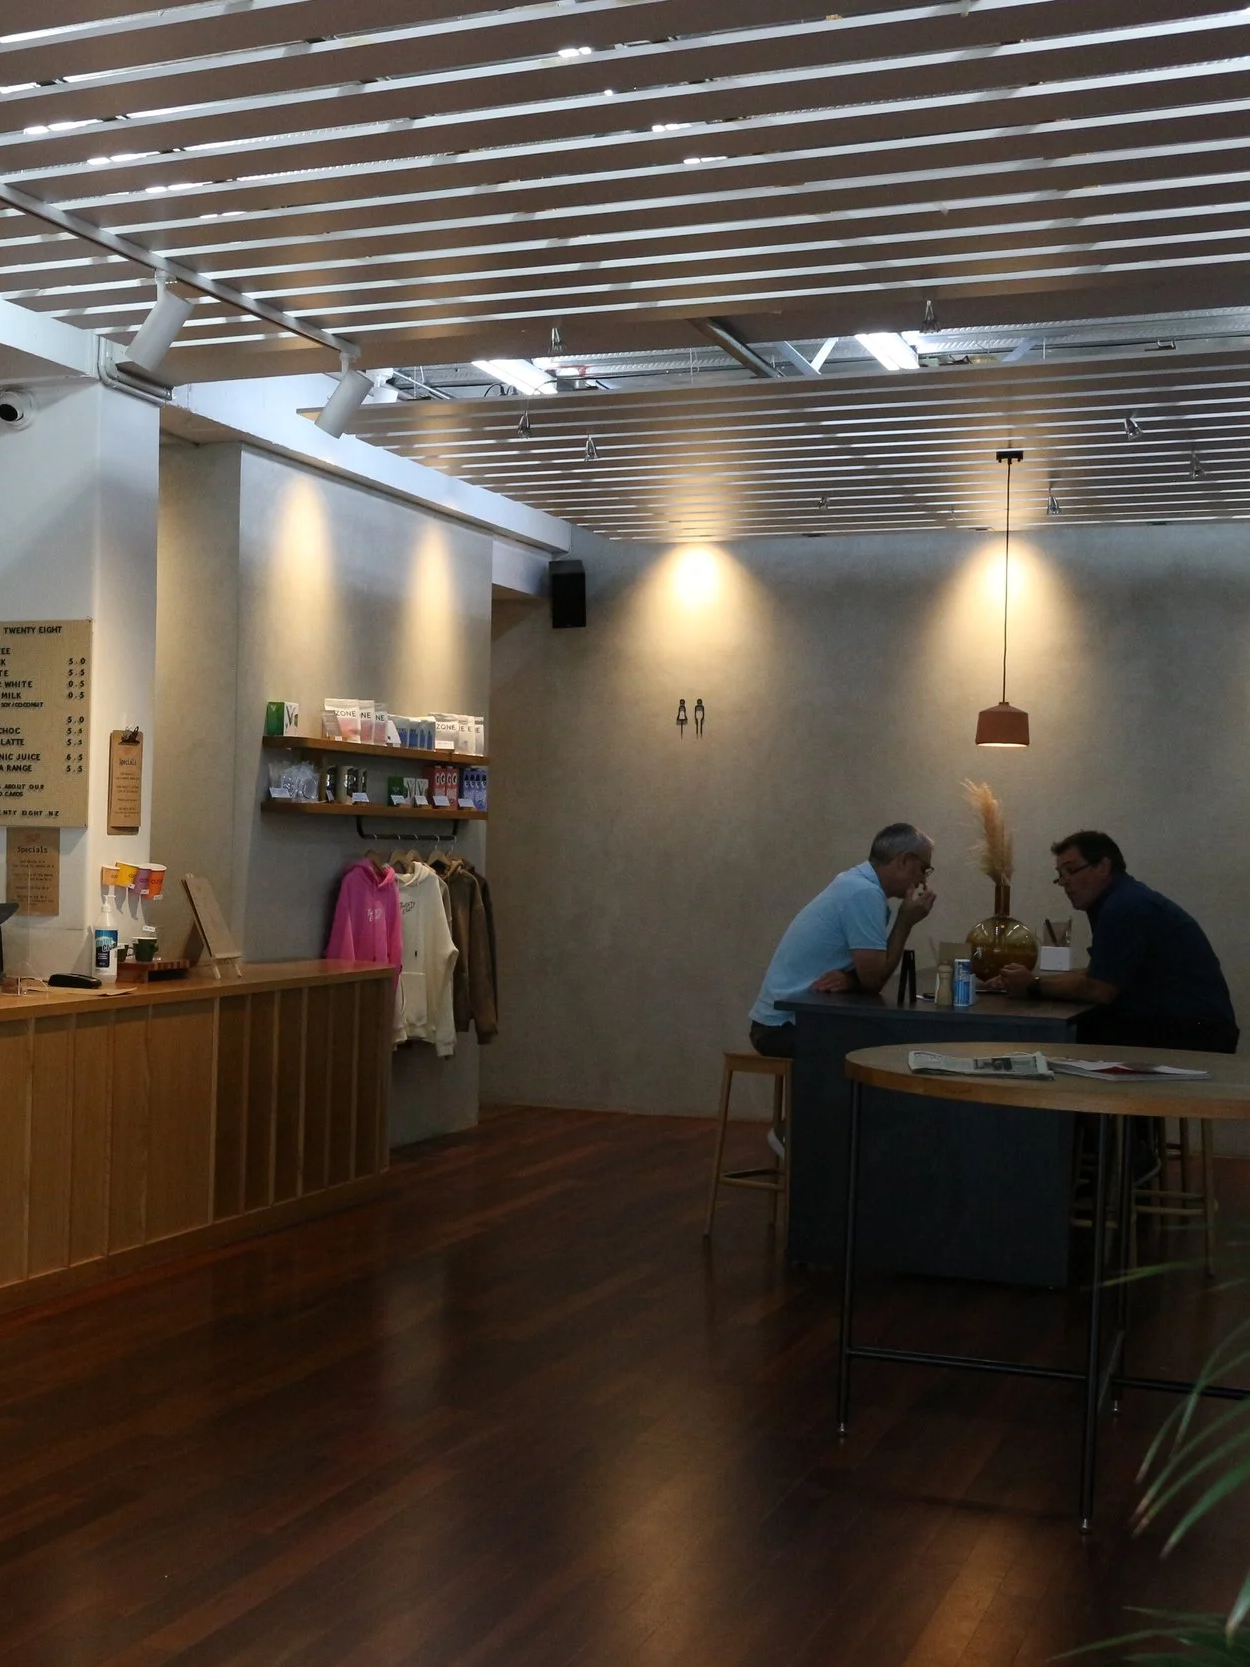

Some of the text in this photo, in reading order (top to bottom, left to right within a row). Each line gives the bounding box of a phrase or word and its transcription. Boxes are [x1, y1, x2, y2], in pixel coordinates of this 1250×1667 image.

[4, 626, 62, 634] TWENTY EIGHT
[18, 846, 48, 854] Specials
